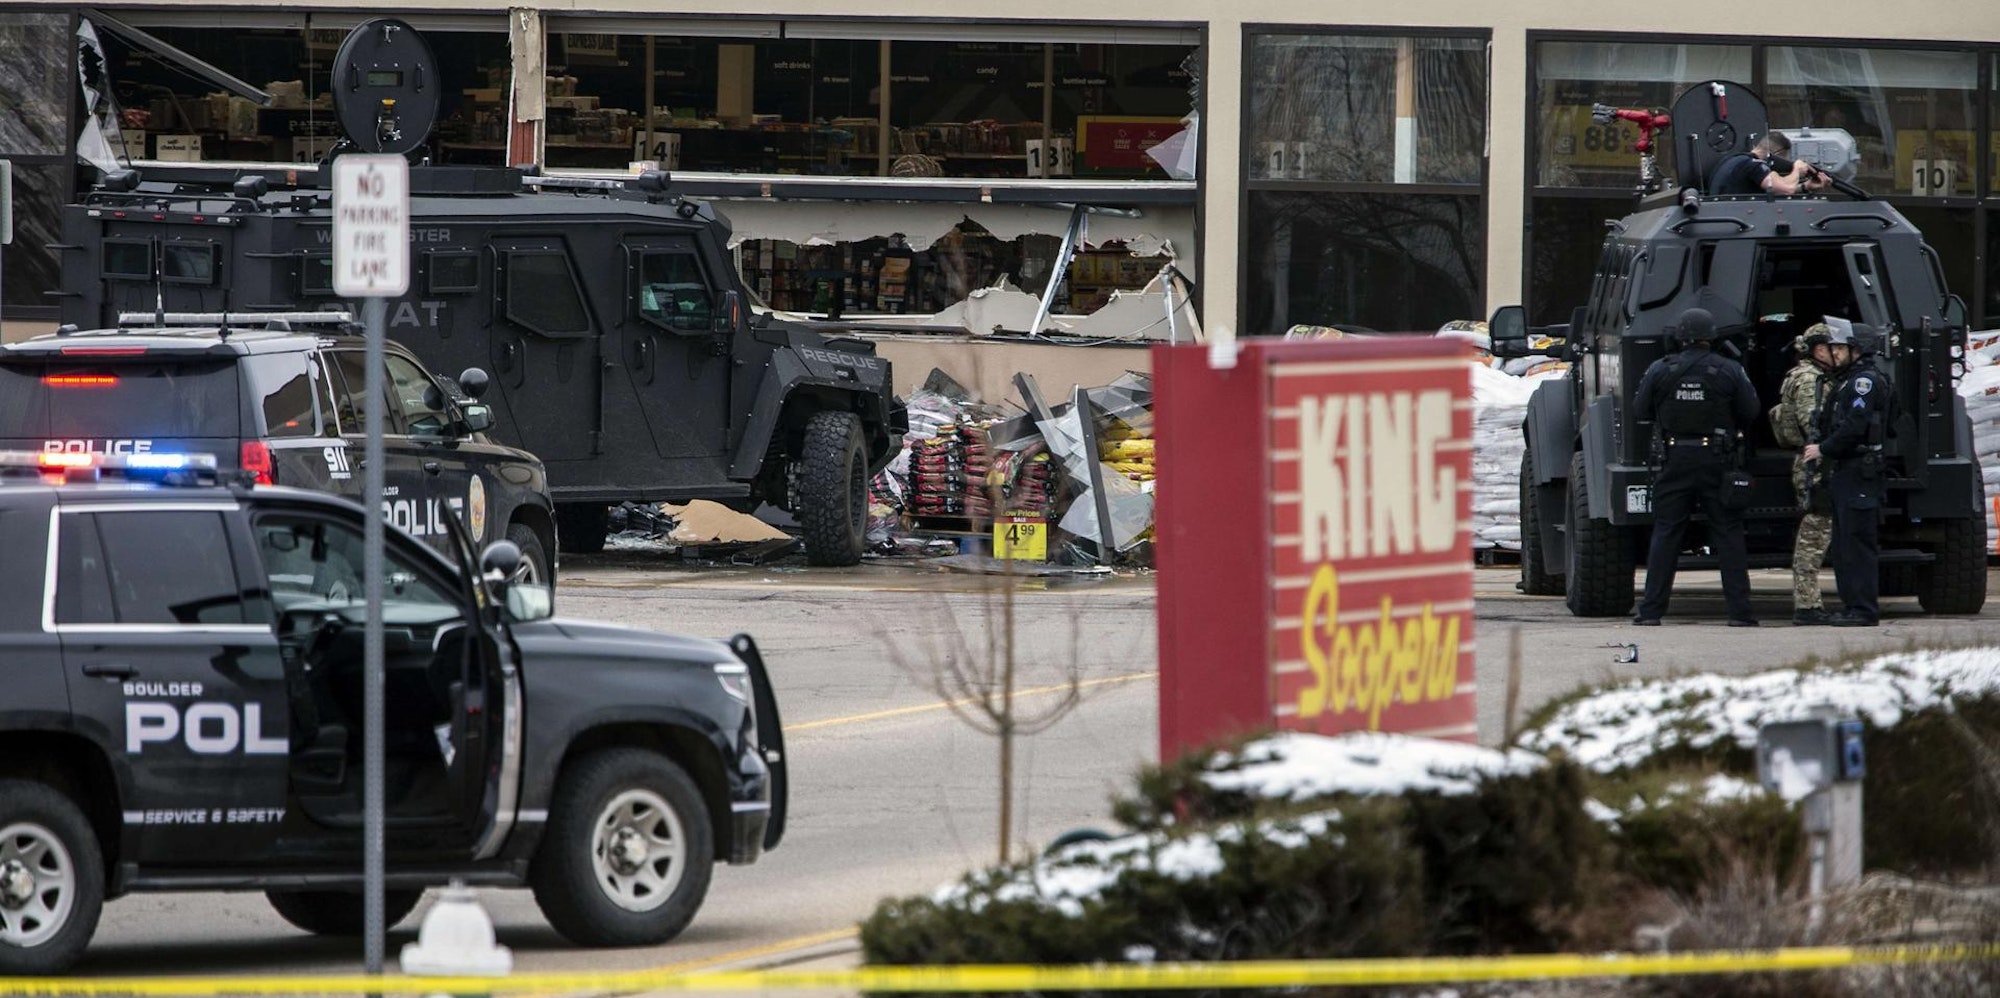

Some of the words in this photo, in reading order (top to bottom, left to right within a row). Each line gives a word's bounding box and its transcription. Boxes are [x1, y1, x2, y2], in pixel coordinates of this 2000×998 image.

[976, 66, 999, 76] candy
[639, 141, 668, 161] 14
[1029, 147, 1059, 168] 13
[357, 172, 386, 199] NO
[1916, 168, 1945, 189] 10
[340, 205, 399, 225] PARKING
[353, 231, 387, 253] FIRE
[351, 258, 389, 280] LANE
[801, 348, 879, 370] RESCUE
[1676, 389, 1705, 401] POLICE
[44, 439, 152, 456] POLICE
[323, 446, 350, 472] 911
[1300, 390, 1457, 563] KING
[1298, 562, 1460, 731] Soopers
[123, 681, 203, 697] BOULDER
[144, 809, 207, 824] SERVICE
